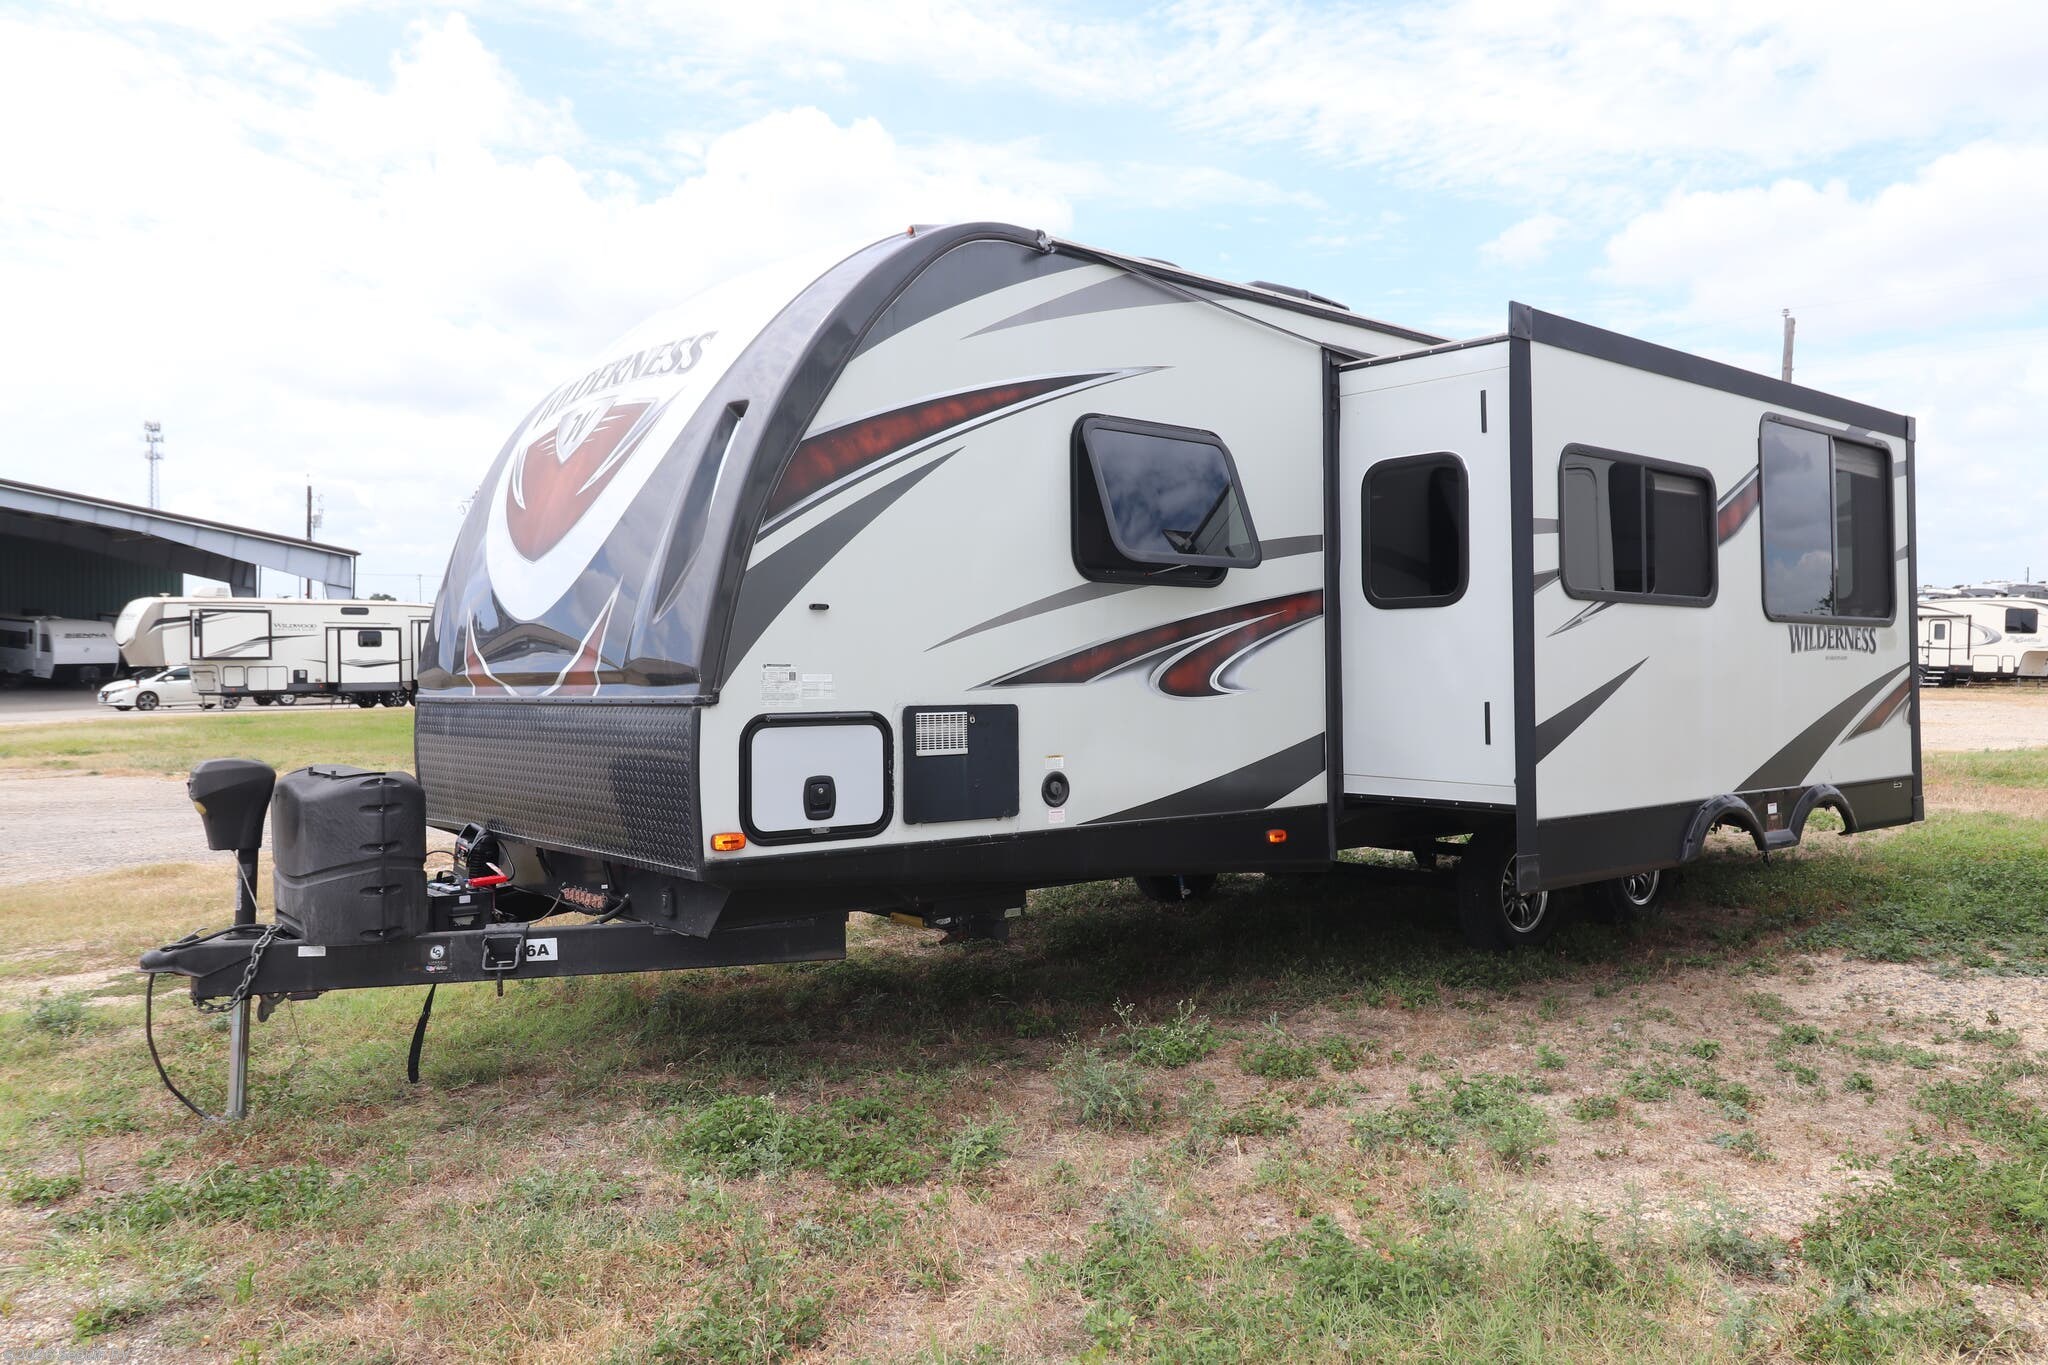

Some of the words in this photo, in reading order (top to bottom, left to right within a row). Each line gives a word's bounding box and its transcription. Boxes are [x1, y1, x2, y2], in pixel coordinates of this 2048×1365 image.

[533, 331, 719, 429] WILDERNESS
[1787, 624, 1877, 655] WILDERNESS
[526, 944, 550, 957] 6A
